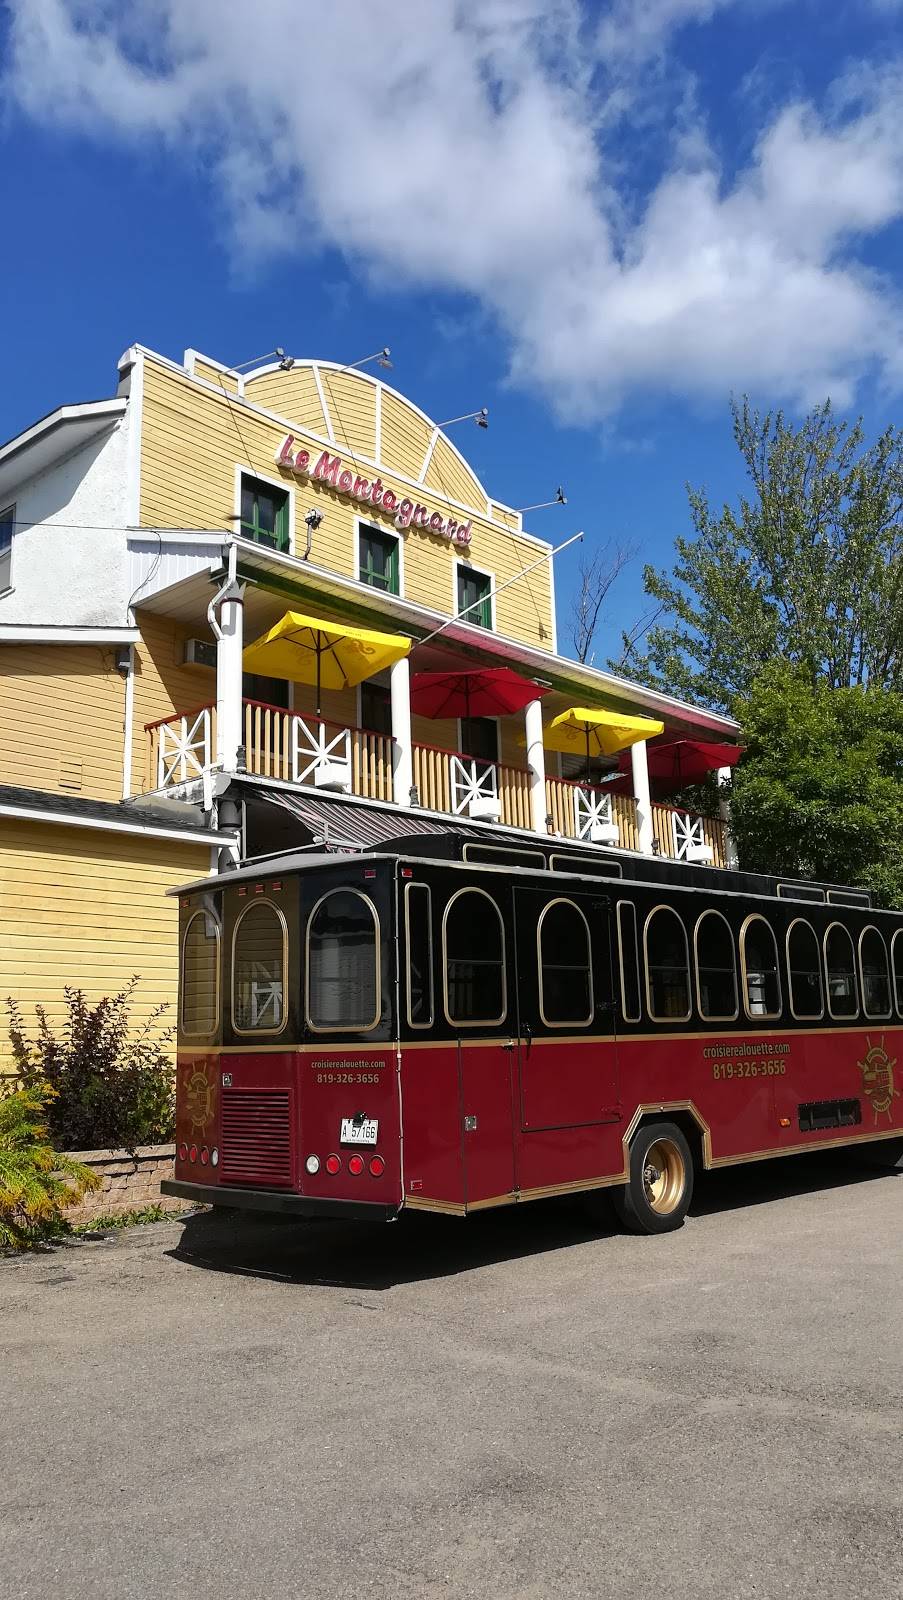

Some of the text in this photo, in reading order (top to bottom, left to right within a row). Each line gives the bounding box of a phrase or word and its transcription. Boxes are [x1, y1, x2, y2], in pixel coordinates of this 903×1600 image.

[275, 434, 473, 547] Le Montagnard
[703, 1042, 791, 1058] croisierealouette.com
[311, 1059, 386, 1069] croisierealouette.com
[713, 1060, 786, 1080] 819-326-3656
[317, 1073, 380, 1083] 819-326-3656
[342, 1124, 348, 1137] A
